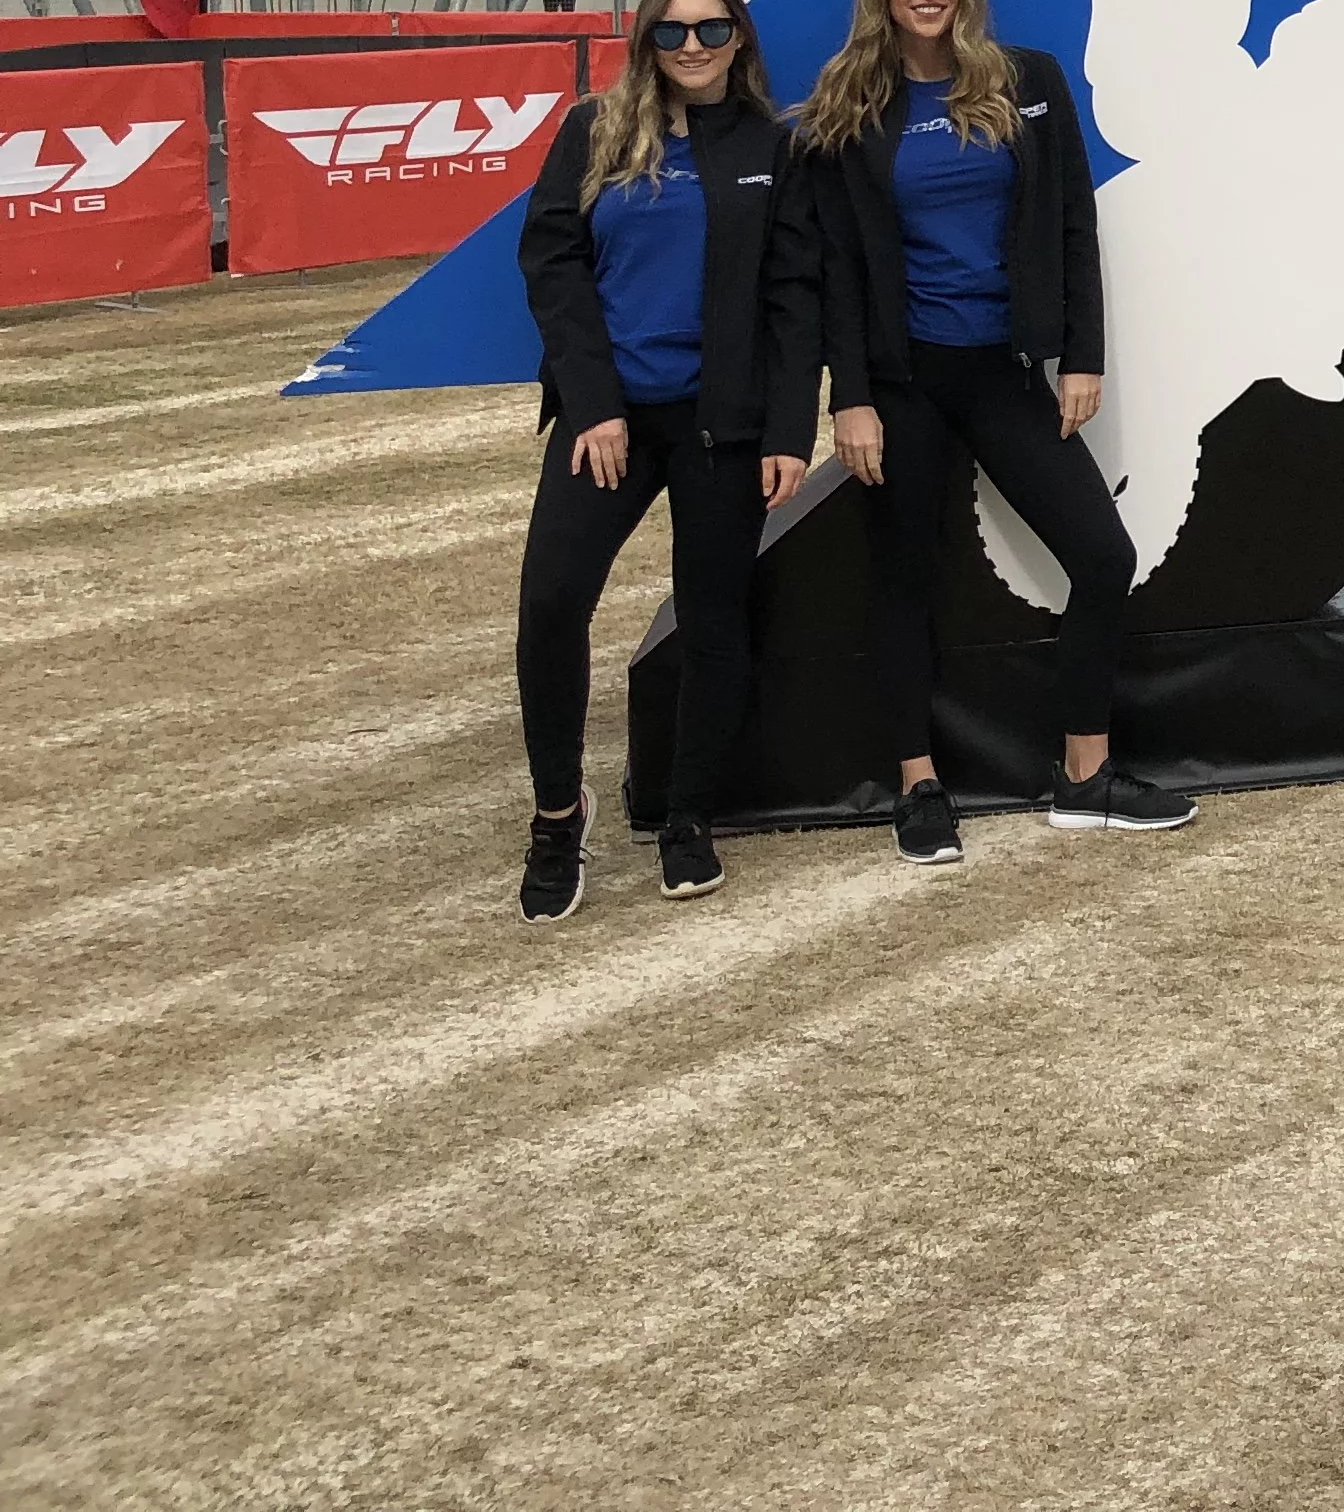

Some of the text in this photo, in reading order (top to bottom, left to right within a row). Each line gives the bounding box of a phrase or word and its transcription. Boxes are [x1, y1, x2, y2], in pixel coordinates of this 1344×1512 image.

[252, 92, 564, 166] FLY
[0, 120, 186, 197] LY
[327, 156, 506, 187] RACING
[8, 194, 106, 219] ING
